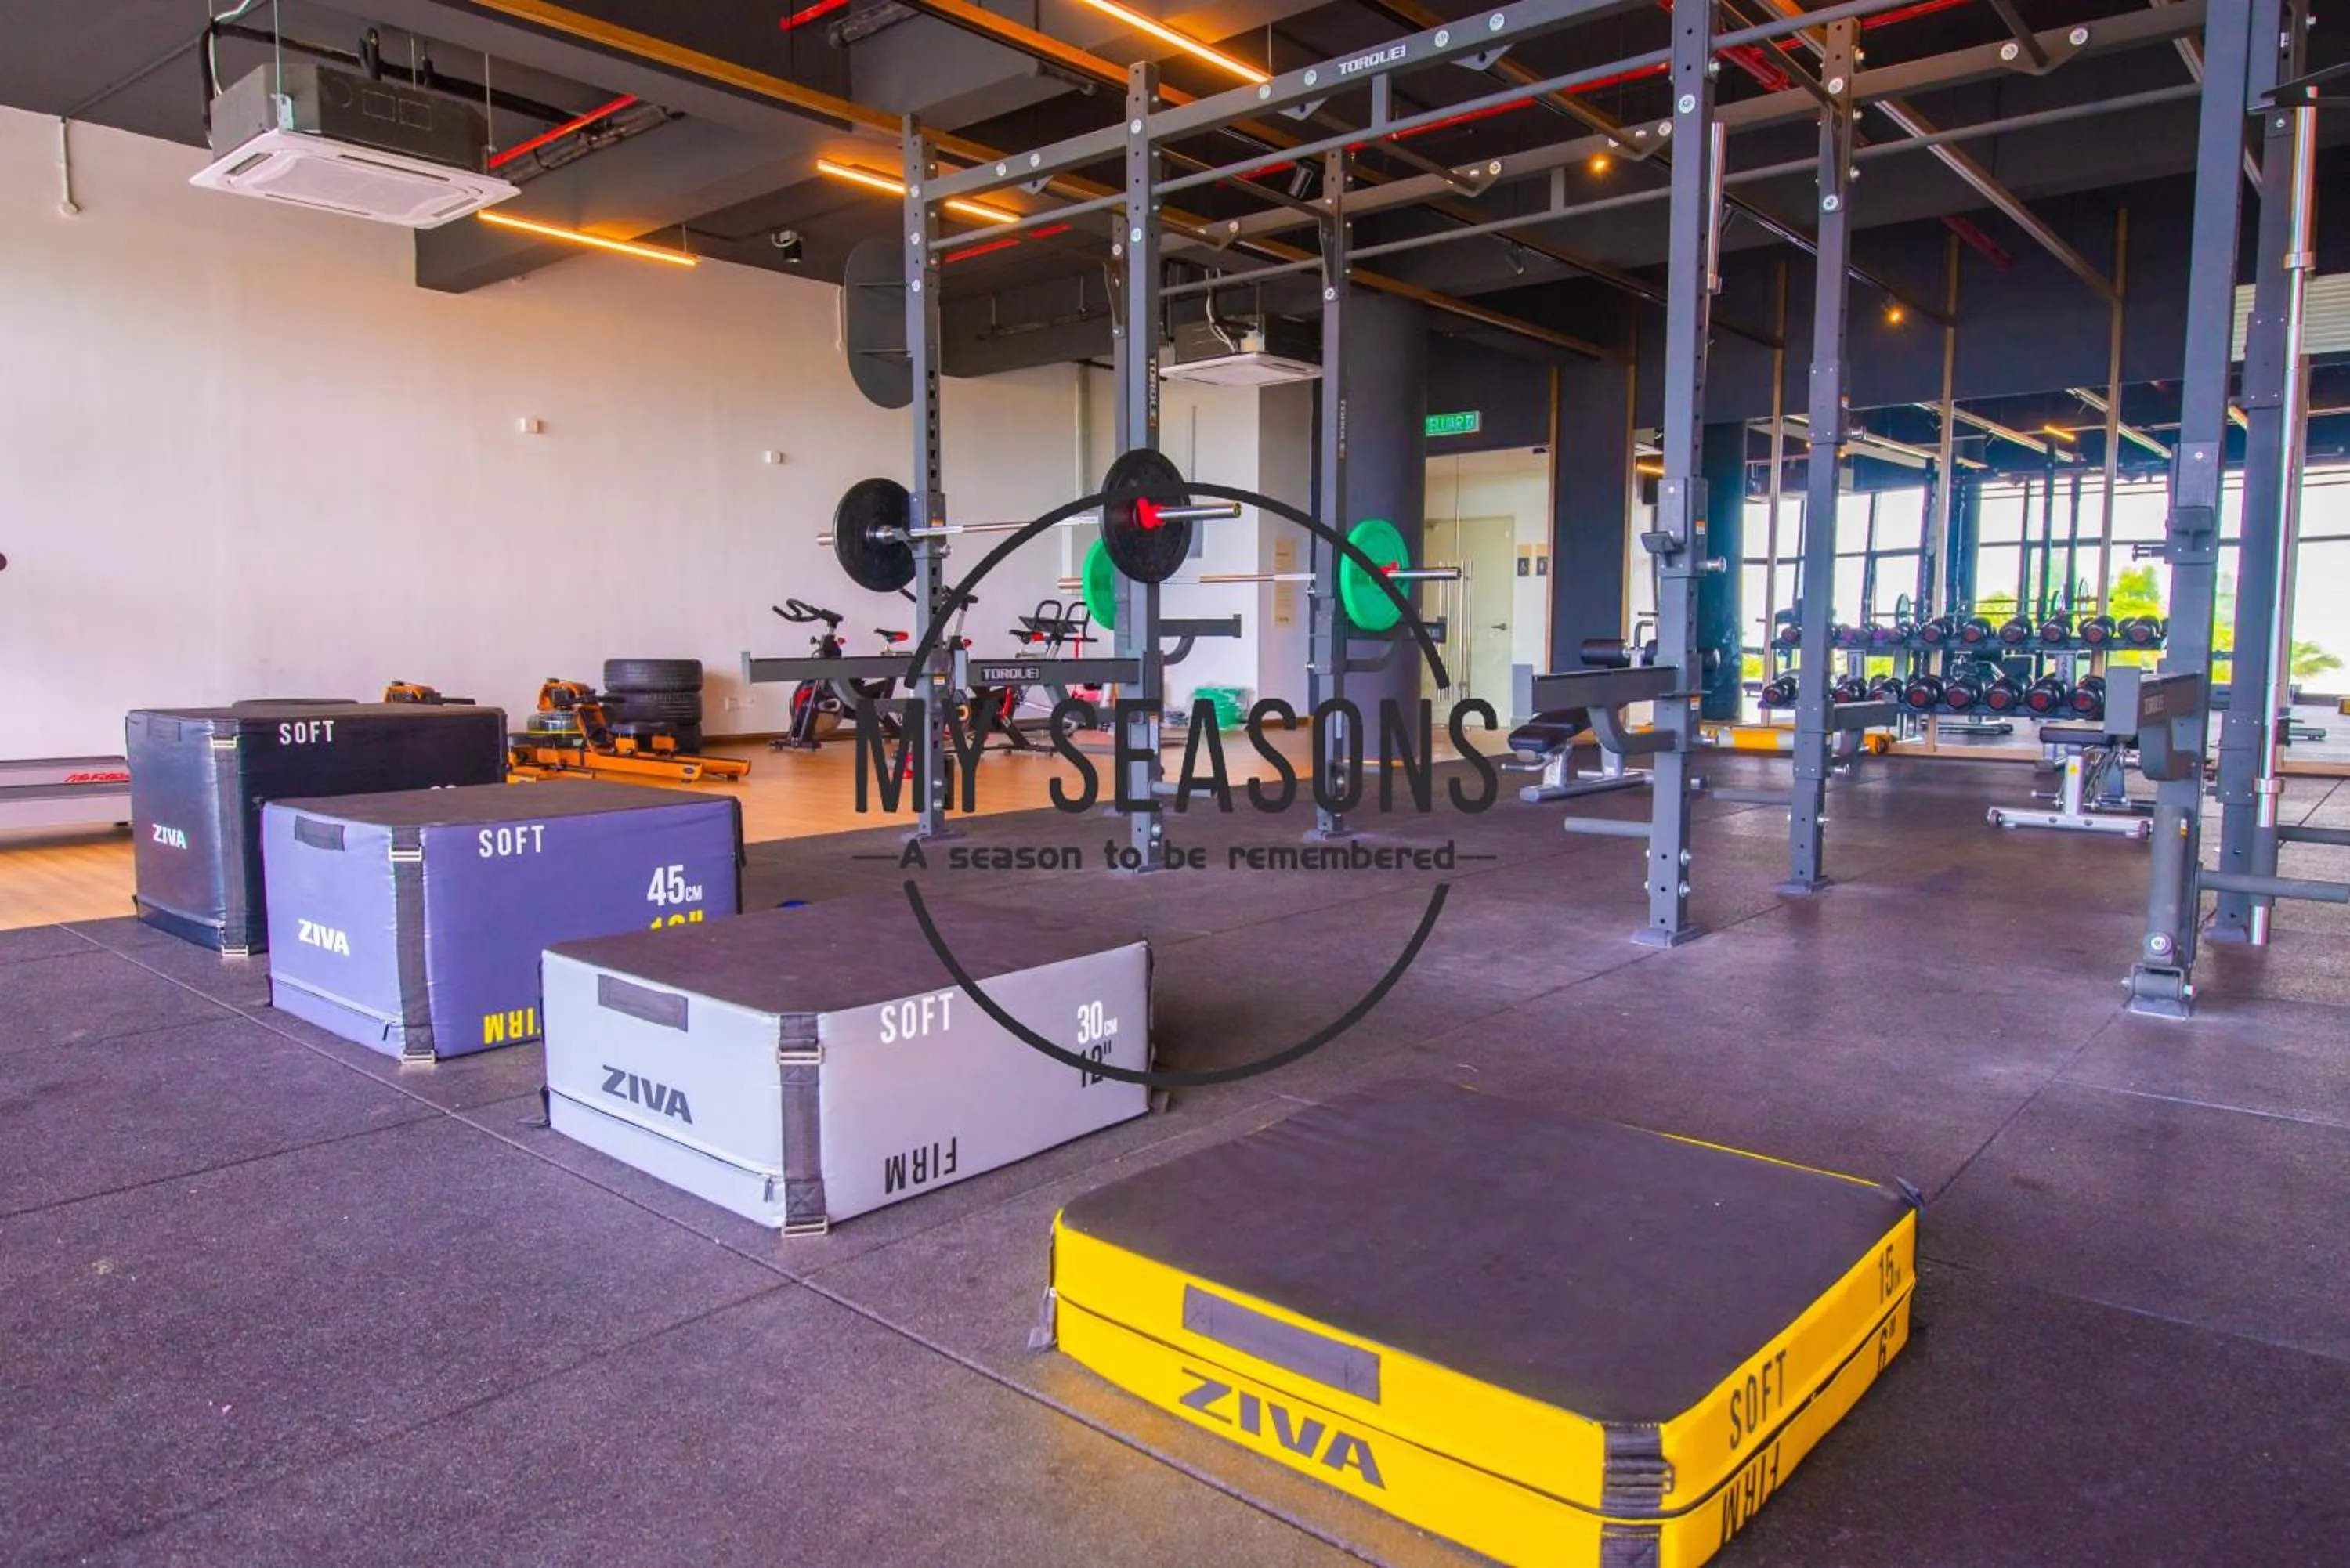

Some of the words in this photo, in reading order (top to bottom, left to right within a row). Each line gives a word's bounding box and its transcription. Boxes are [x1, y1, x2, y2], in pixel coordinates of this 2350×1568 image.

[279, 720, 334, 745] SOFT
[152, 823, 187, 850] ZIVA
[479, 825, 545, 858] SOFT
[298, 918, 350, 956] ZIVA
[483, 1007, 542, 1045] IRM
[880, 992, 953, 1044] SOFT
[602, 1064, 692, 1124] ZIVA
[884, 1137, 957, 1194] FIRM
[1730, 1349, 1787, 1451] SOFT
[1180, 1367, 1386, 1490] ZIVA
